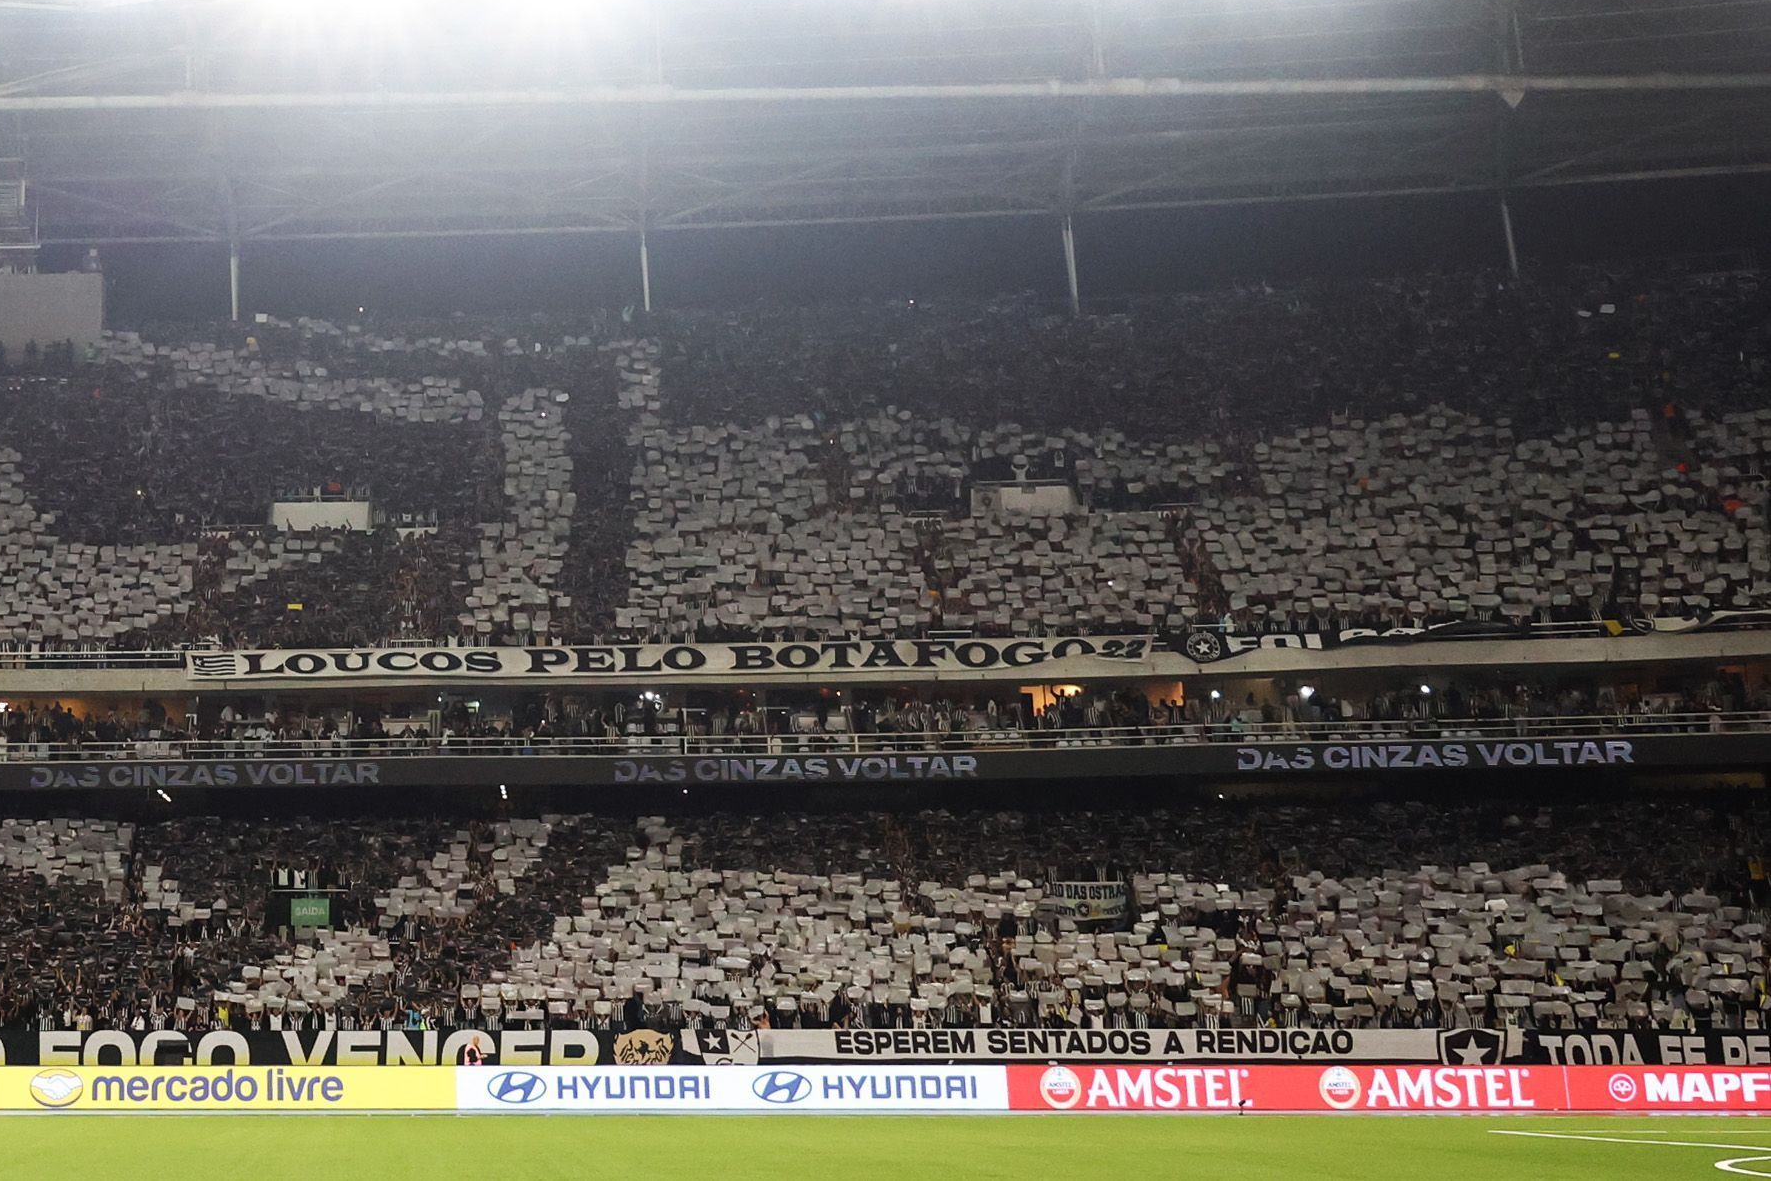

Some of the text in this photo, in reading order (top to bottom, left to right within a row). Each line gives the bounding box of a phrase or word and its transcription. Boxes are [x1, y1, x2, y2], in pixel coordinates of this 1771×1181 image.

[240, 651, 502, 675] LOUCOS
[523, 646, 707, 673] PELO
[728, 638, 1096, 670] BOTAFOGO
[614, 755, 978, 783] DAS CINZAS VOLTAR
[1238, 740, 1635, 770] DAS CINZAS VOLTAR
[30, 762, 380, 789] DAS CINZAS VOLTAR
[834, 1030, 976, 1055] ESPEREM
[987, 1030, 1151, 1055] SENTADOS
[1163, 1030, 1185, 1055] A
[1539, 1033, 1645, 1066] TODA
[91, 1068, 344, 1103] mercado livre
[557, 1075, 710, 1100] HYUNDAI
[822, 1075, 977, 1100] HYUNDAI
[1086, 1068, 1253, 1108] AMSTEL
[1367, 1068, 1535, 1108] AMSTEL
